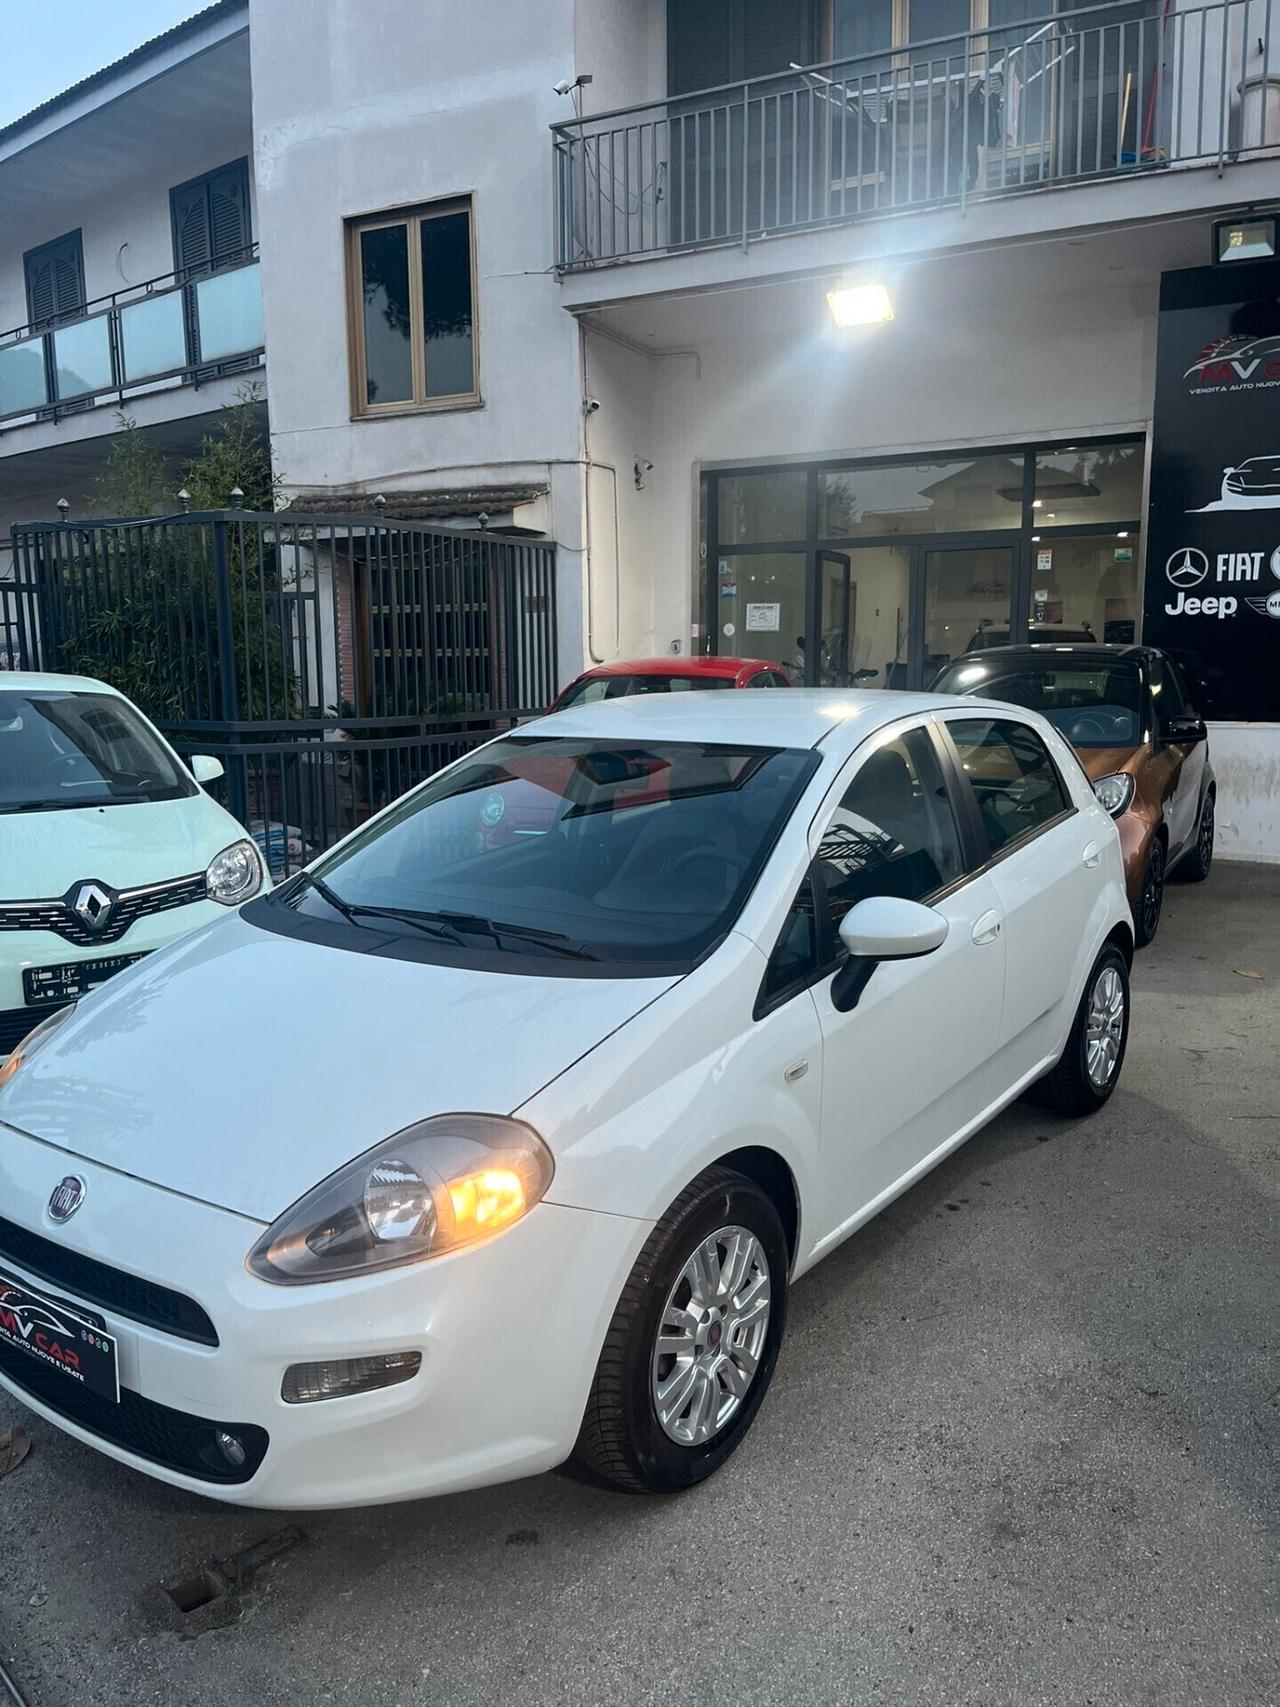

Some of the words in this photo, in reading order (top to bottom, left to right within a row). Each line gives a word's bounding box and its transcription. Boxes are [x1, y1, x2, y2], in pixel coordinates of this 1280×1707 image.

[1200, 359, 1261, 382] MV
[1189, 386, 1227, 394] VENDITA
[1229, 383, 1254, 391] AUTO
[1216, 552, 1265, 582] FIAT
[1164, 591, 1238, 619] Jeep
[54, 1186, 78, 1210] FIAT
[12, 1335, 31, 1349] AUTO
[31, 1345, 56, 1365] NUOVE
[61, 1363, 85, 1382] USATE
[35, 1333, 80, 1370] CAR
